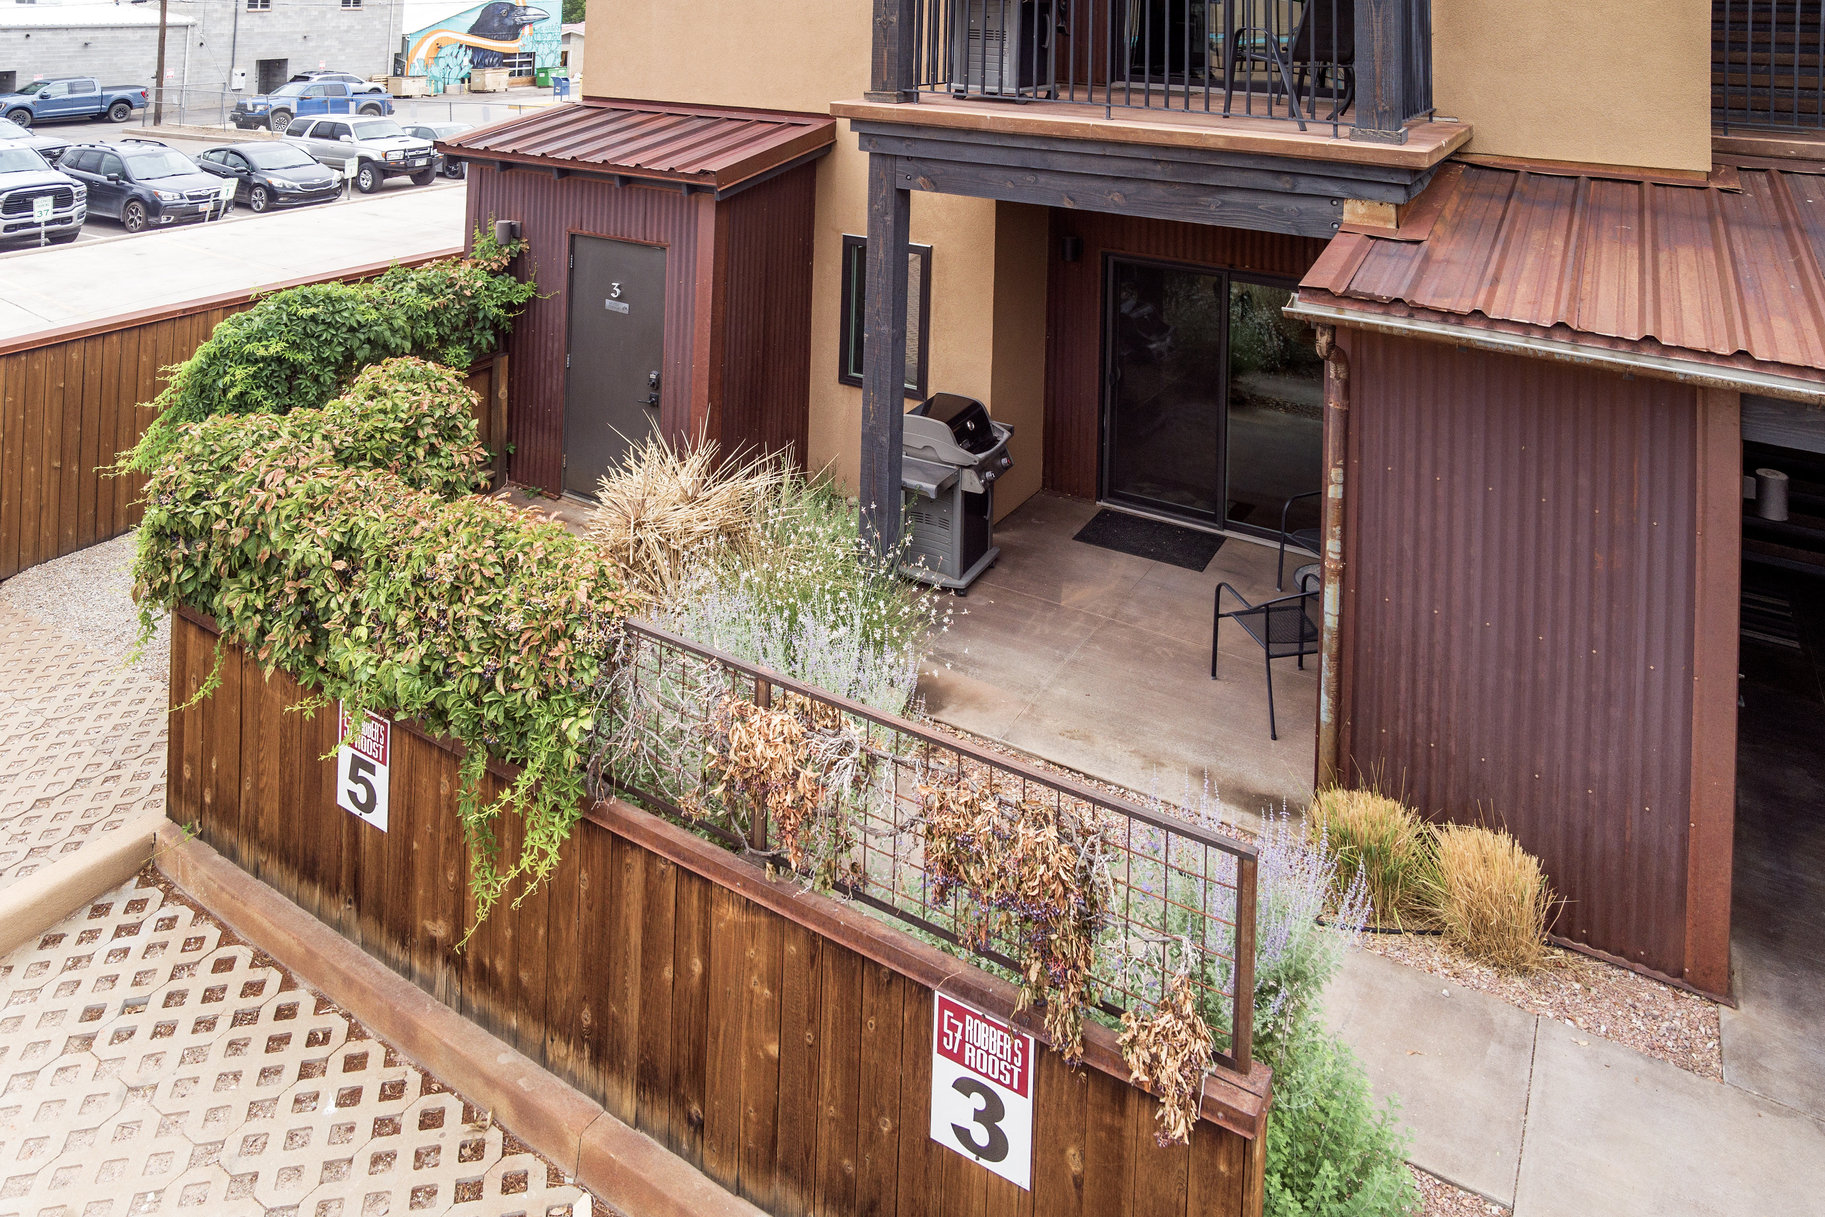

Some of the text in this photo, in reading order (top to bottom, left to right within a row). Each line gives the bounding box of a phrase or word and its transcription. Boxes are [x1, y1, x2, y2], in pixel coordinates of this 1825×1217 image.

[37, 209, 49, 218] 37
[610, 282, 621, 298] 3
[347, 752, 377, 814] 5
[943, 1009, 963, 1054] 57
[965, 1014, 1022, 1067] ROBBER'S
[964, 1043, 1022, 1090] ROOST
[951, 1076, 1009, 1163] 3
